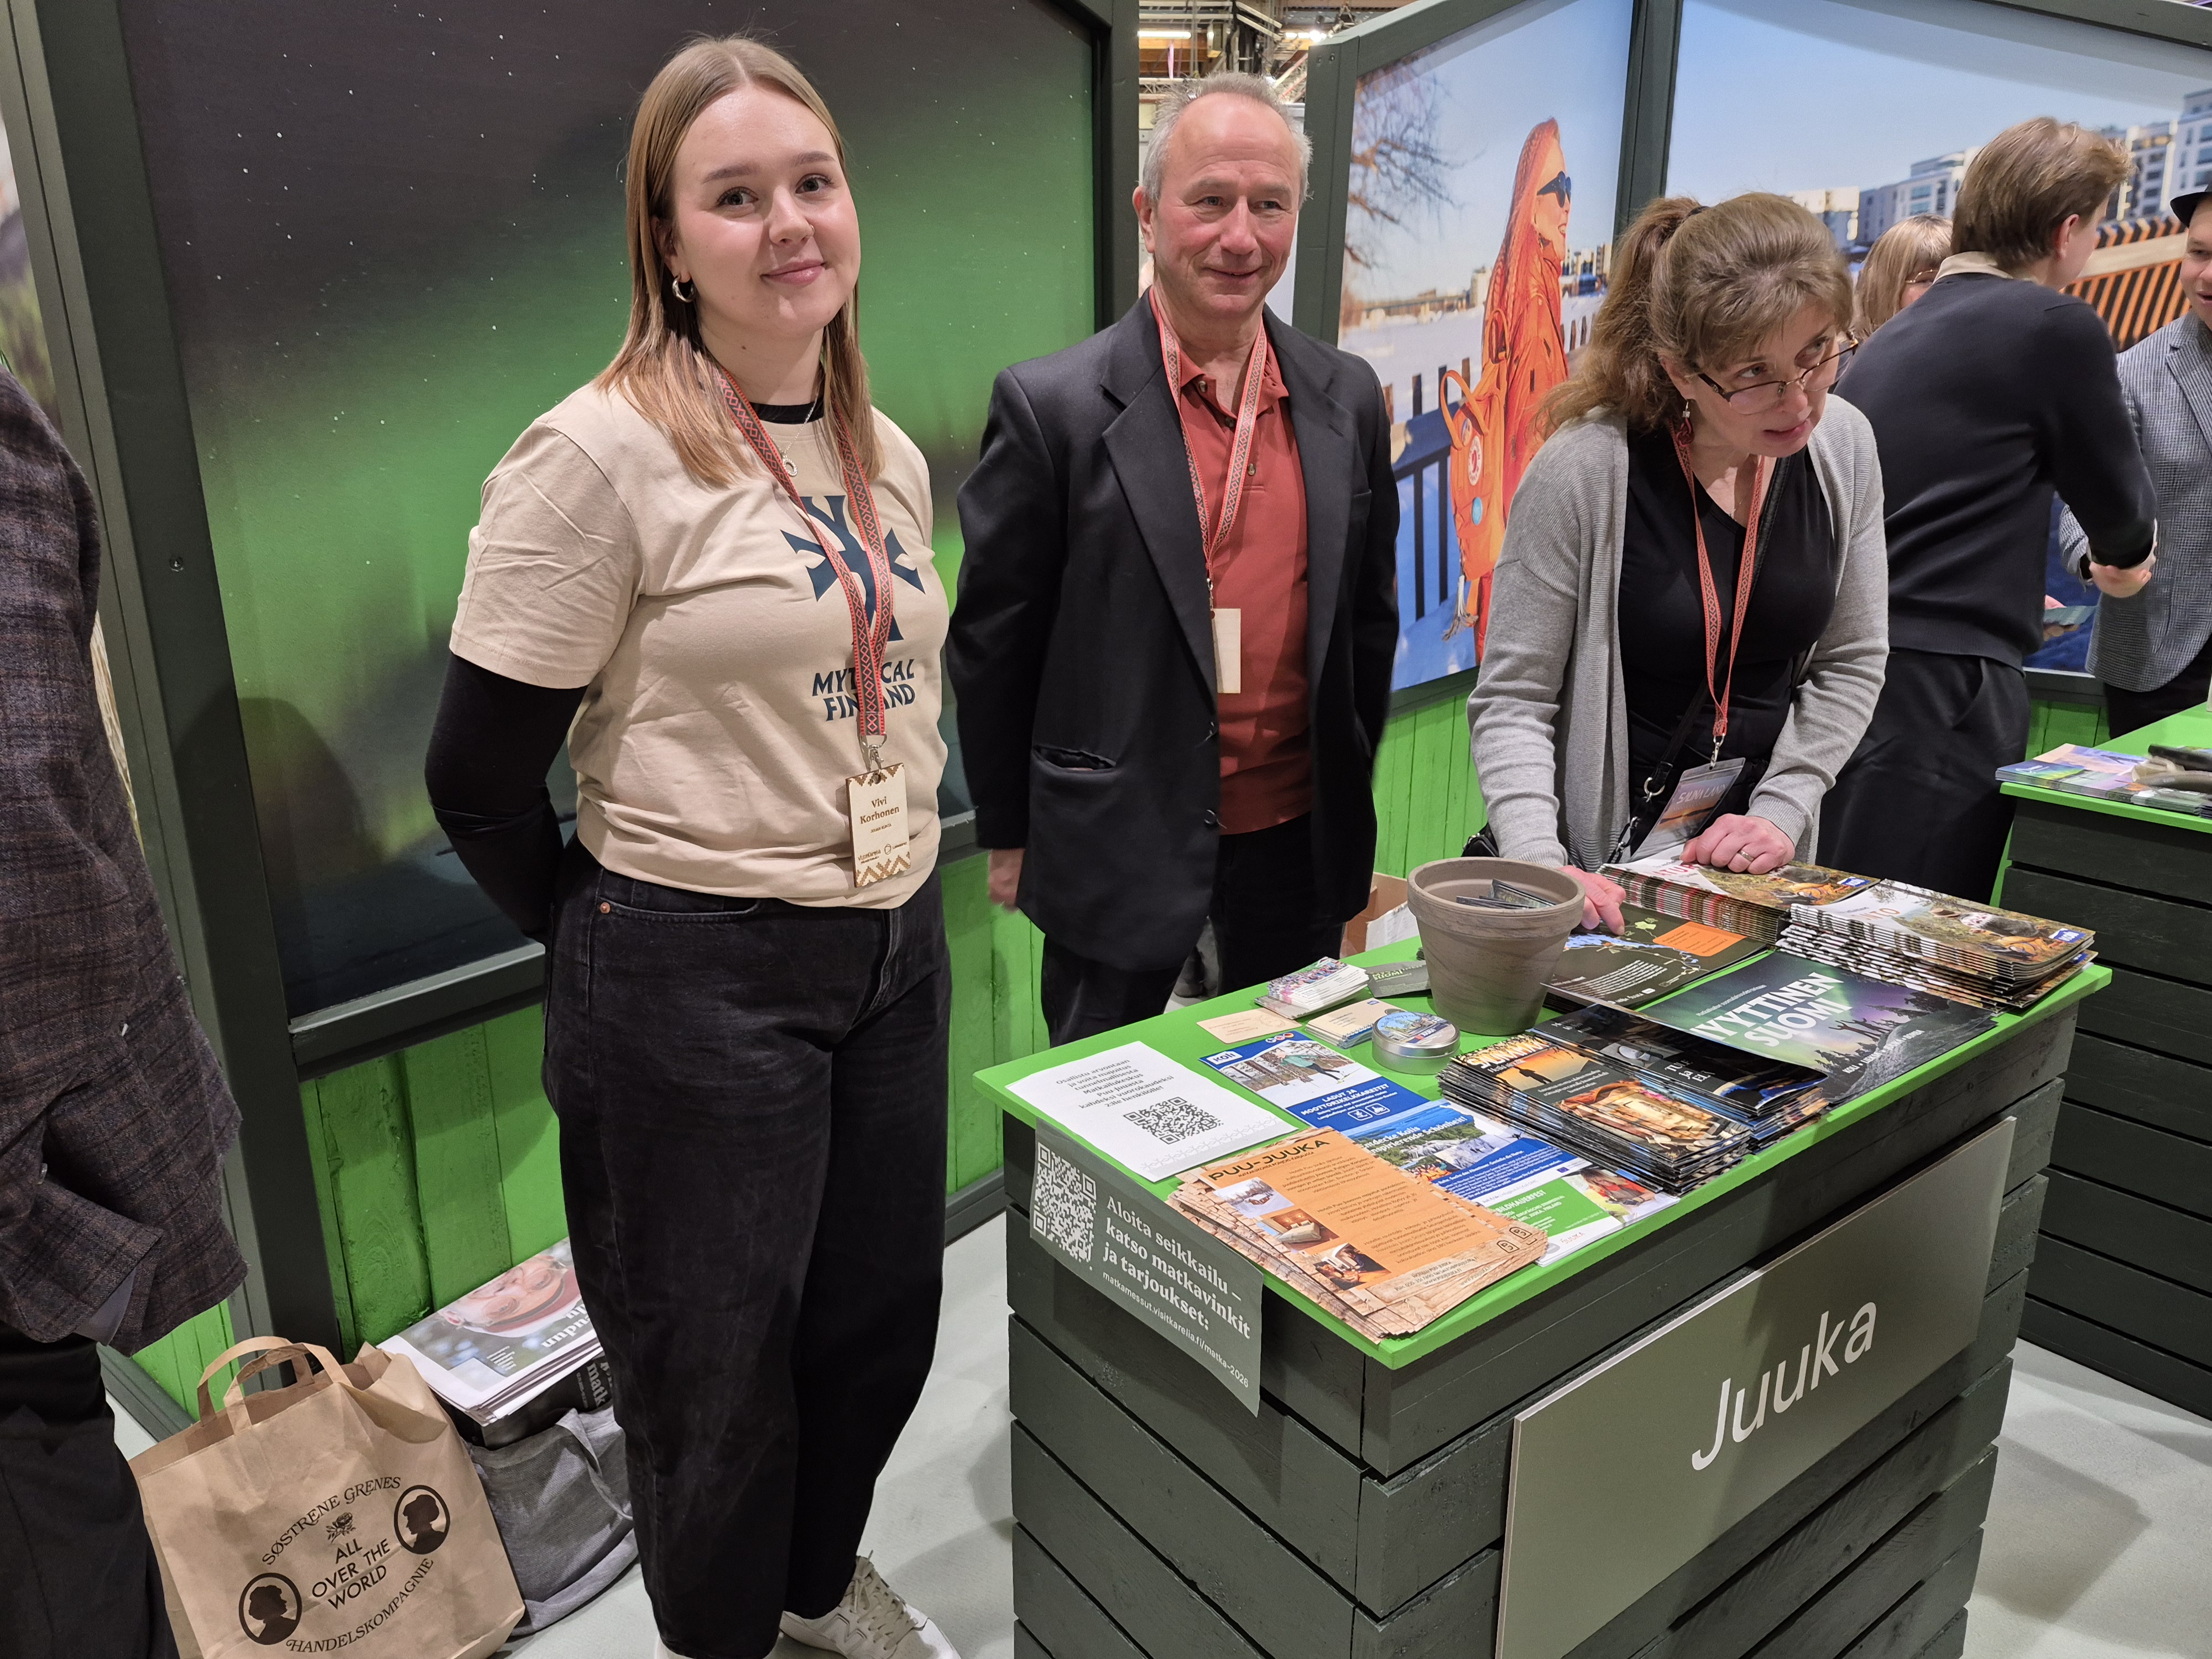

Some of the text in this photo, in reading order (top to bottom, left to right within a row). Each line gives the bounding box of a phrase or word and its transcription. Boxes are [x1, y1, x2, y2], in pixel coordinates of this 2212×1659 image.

[812, 659, 915, 696] MYTCAL
[823, 684, 916, 722] FINND
[860, 806, 900, 824] Korhonen
[871, 796, 887, 808] Vivi
[1744, 997, 1853, 1047] SUOMI
[1056, 1059, 1130, 1084] Osallistu arvontaan
[1074, 1068, 1139, 1091] tunnelmallisesta
[1078, 1075, 1097, 1084] voita
[1098, 1065, 1131, 1079] majoitus
[1083, 1073, 1144, 1095] Matkailukeskus
[1097, 1079, 1144, 1097] Puu-Juuasta
[1682, 1069, 1695, 1079] ja
[1079, 1075, 1175, 1109] kahdeksi vuorokaudeksi
[1322, 1092, 1346, 1103] LADUT
[1370, 1115, 1468, 1154] nspirierende Schönheit!
[1396, 1126, 1421, 1137] Kolis
[1208, 1140, 1330, 1181] PUU-JUUKA
[1495, 1190, 1547, 1212] BILDHAUERFEST
[1107, 1196, 1152, 1238] Aloita
[1155, 1234, 1228, 1294] seikkailu
[1103, 1242, 1210, 1331] ja tarjoukset:
[1106, 1217, 1251, 1340] katso matkavinkit
[1103, 1271, 1249, 1389] matkamessut.visitkarelia.fi/matka-2026
[1692, 1301, 1877, 1470] Juuka
[262, 1476, 401, 1566] SØSTRENE GRENES
[312, 1538, 391, 1598] OVER THE
[335, 1538, 363, 1564] ALL
[285, 1558, 434, 1653] HANDELSKOMPAGNIE
[327, 1565, 387, 1610] WORLD
